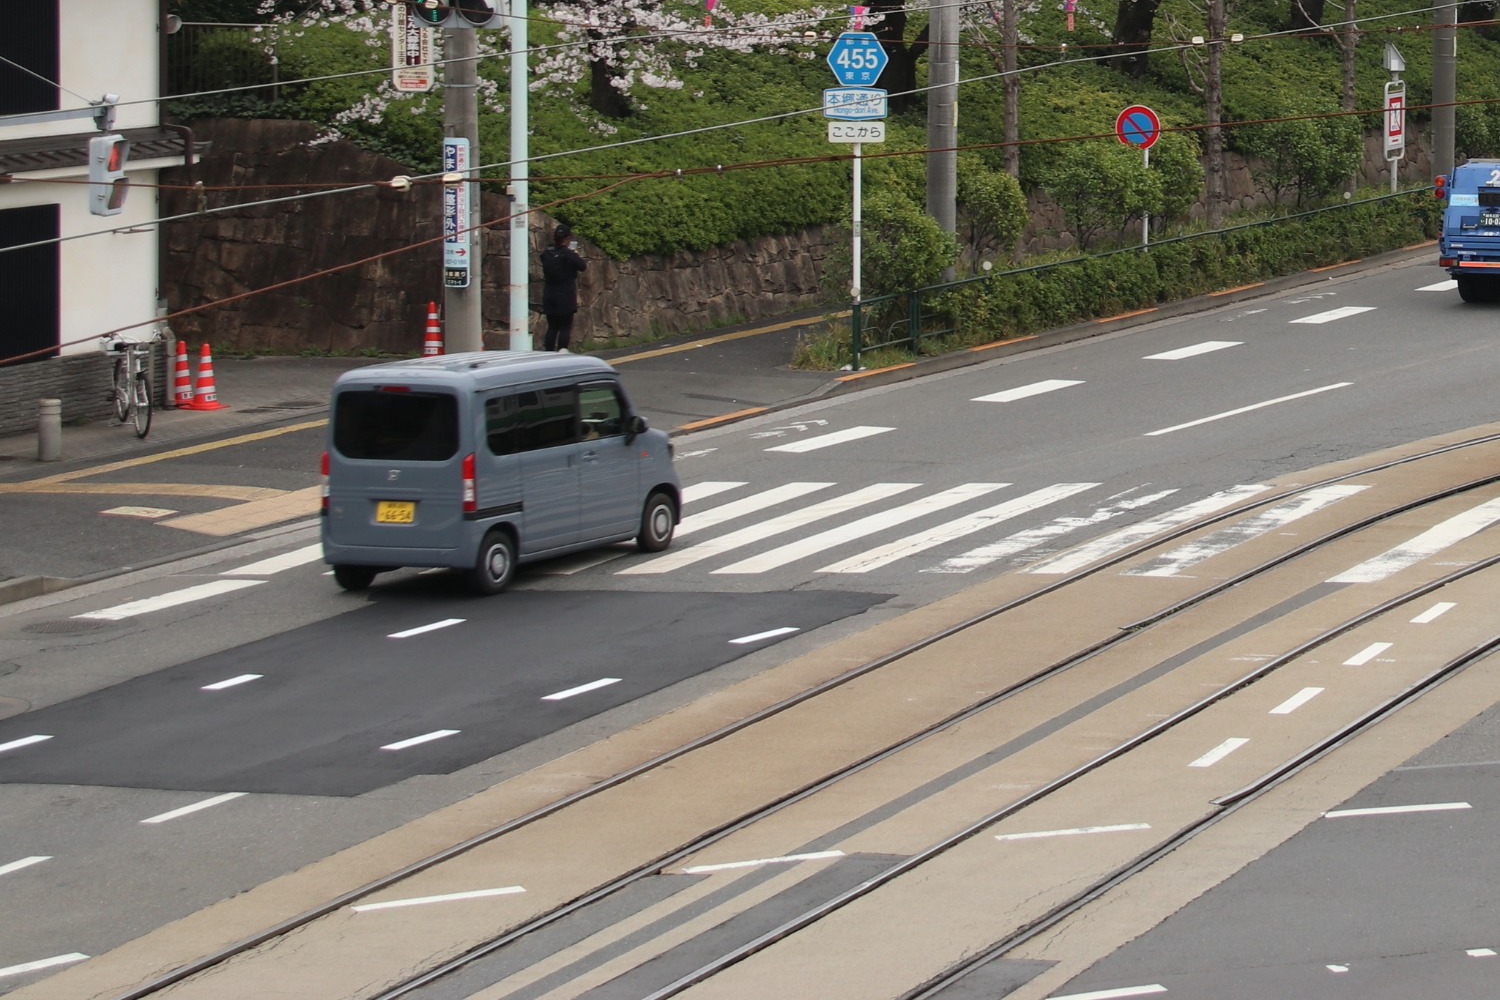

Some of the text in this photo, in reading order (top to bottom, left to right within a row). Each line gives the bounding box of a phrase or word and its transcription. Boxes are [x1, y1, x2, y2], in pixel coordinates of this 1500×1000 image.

[836, 48, 879, 69] 455
[827, 92, 882, 107] 本郷通り
[832, 126, 882, 138] ここから
